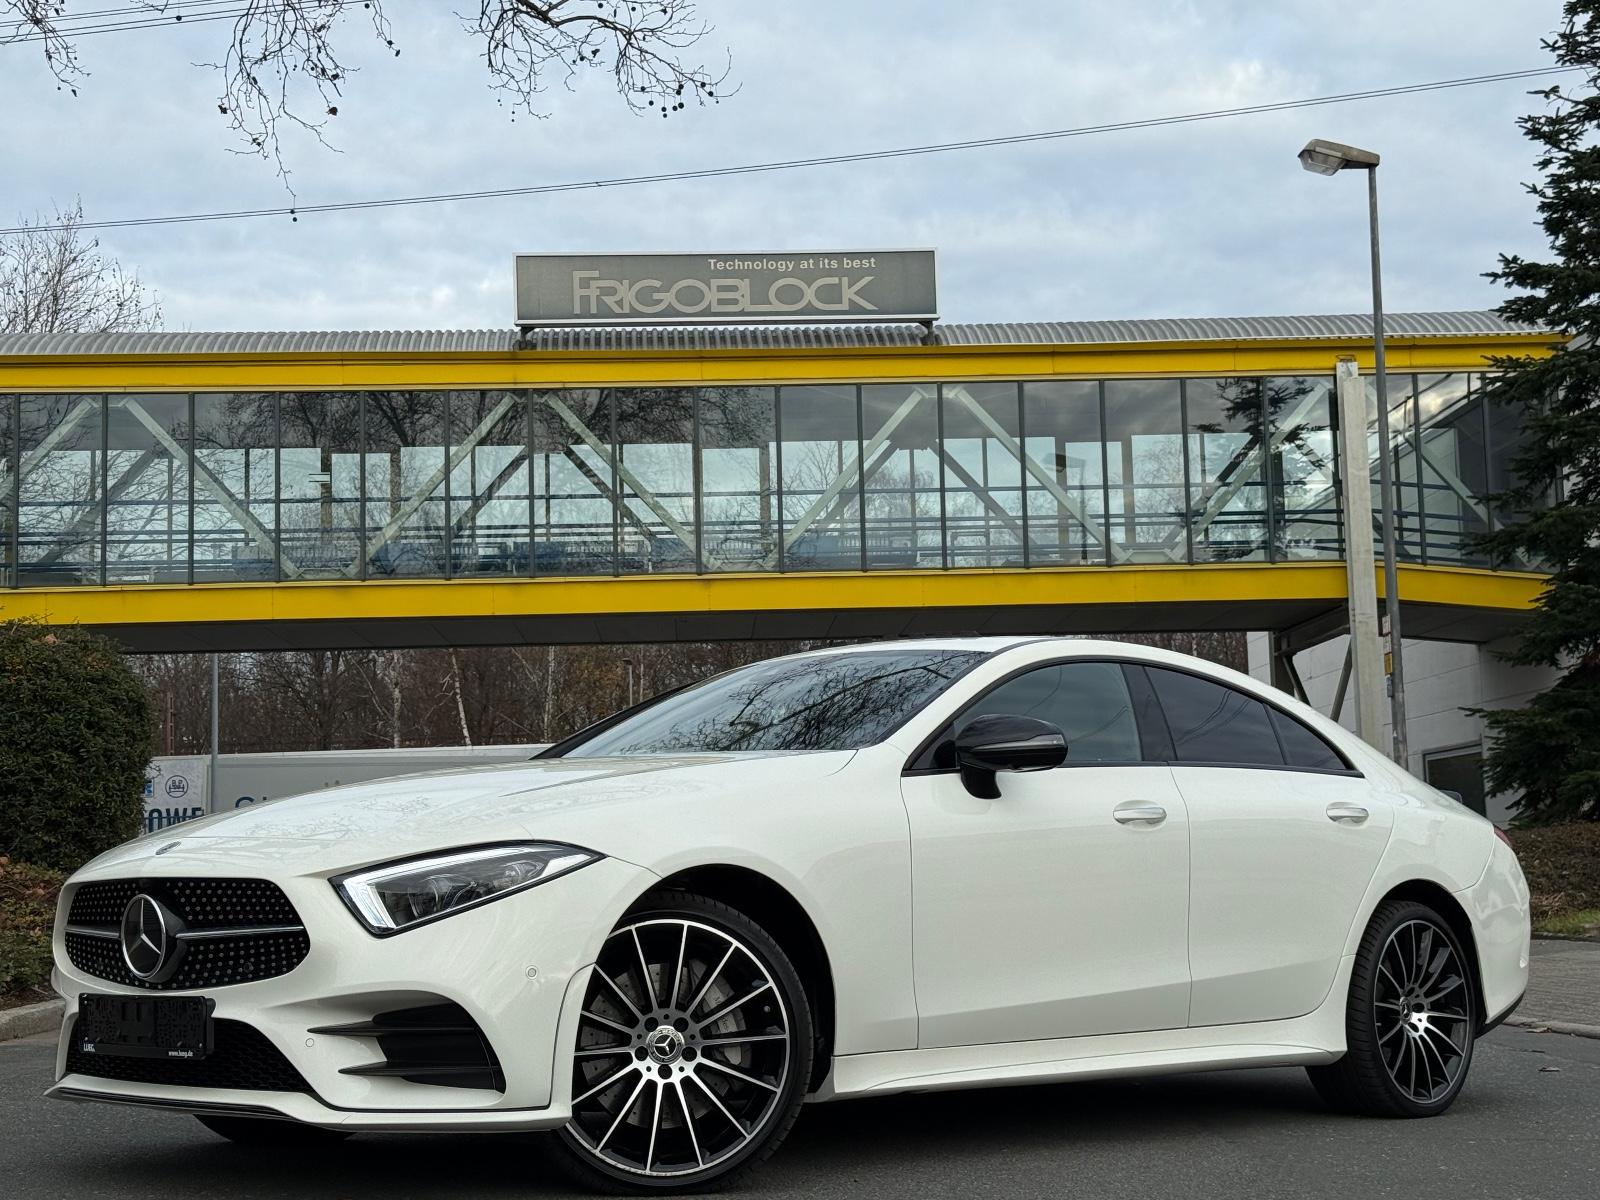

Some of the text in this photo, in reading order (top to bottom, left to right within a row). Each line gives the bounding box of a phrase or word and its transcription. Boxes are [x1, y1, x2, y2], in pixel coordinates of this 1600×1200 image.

[708, 256, 877, 272] Technology at its best
[572, 270, 879, 314] FRIGOBLOCK
